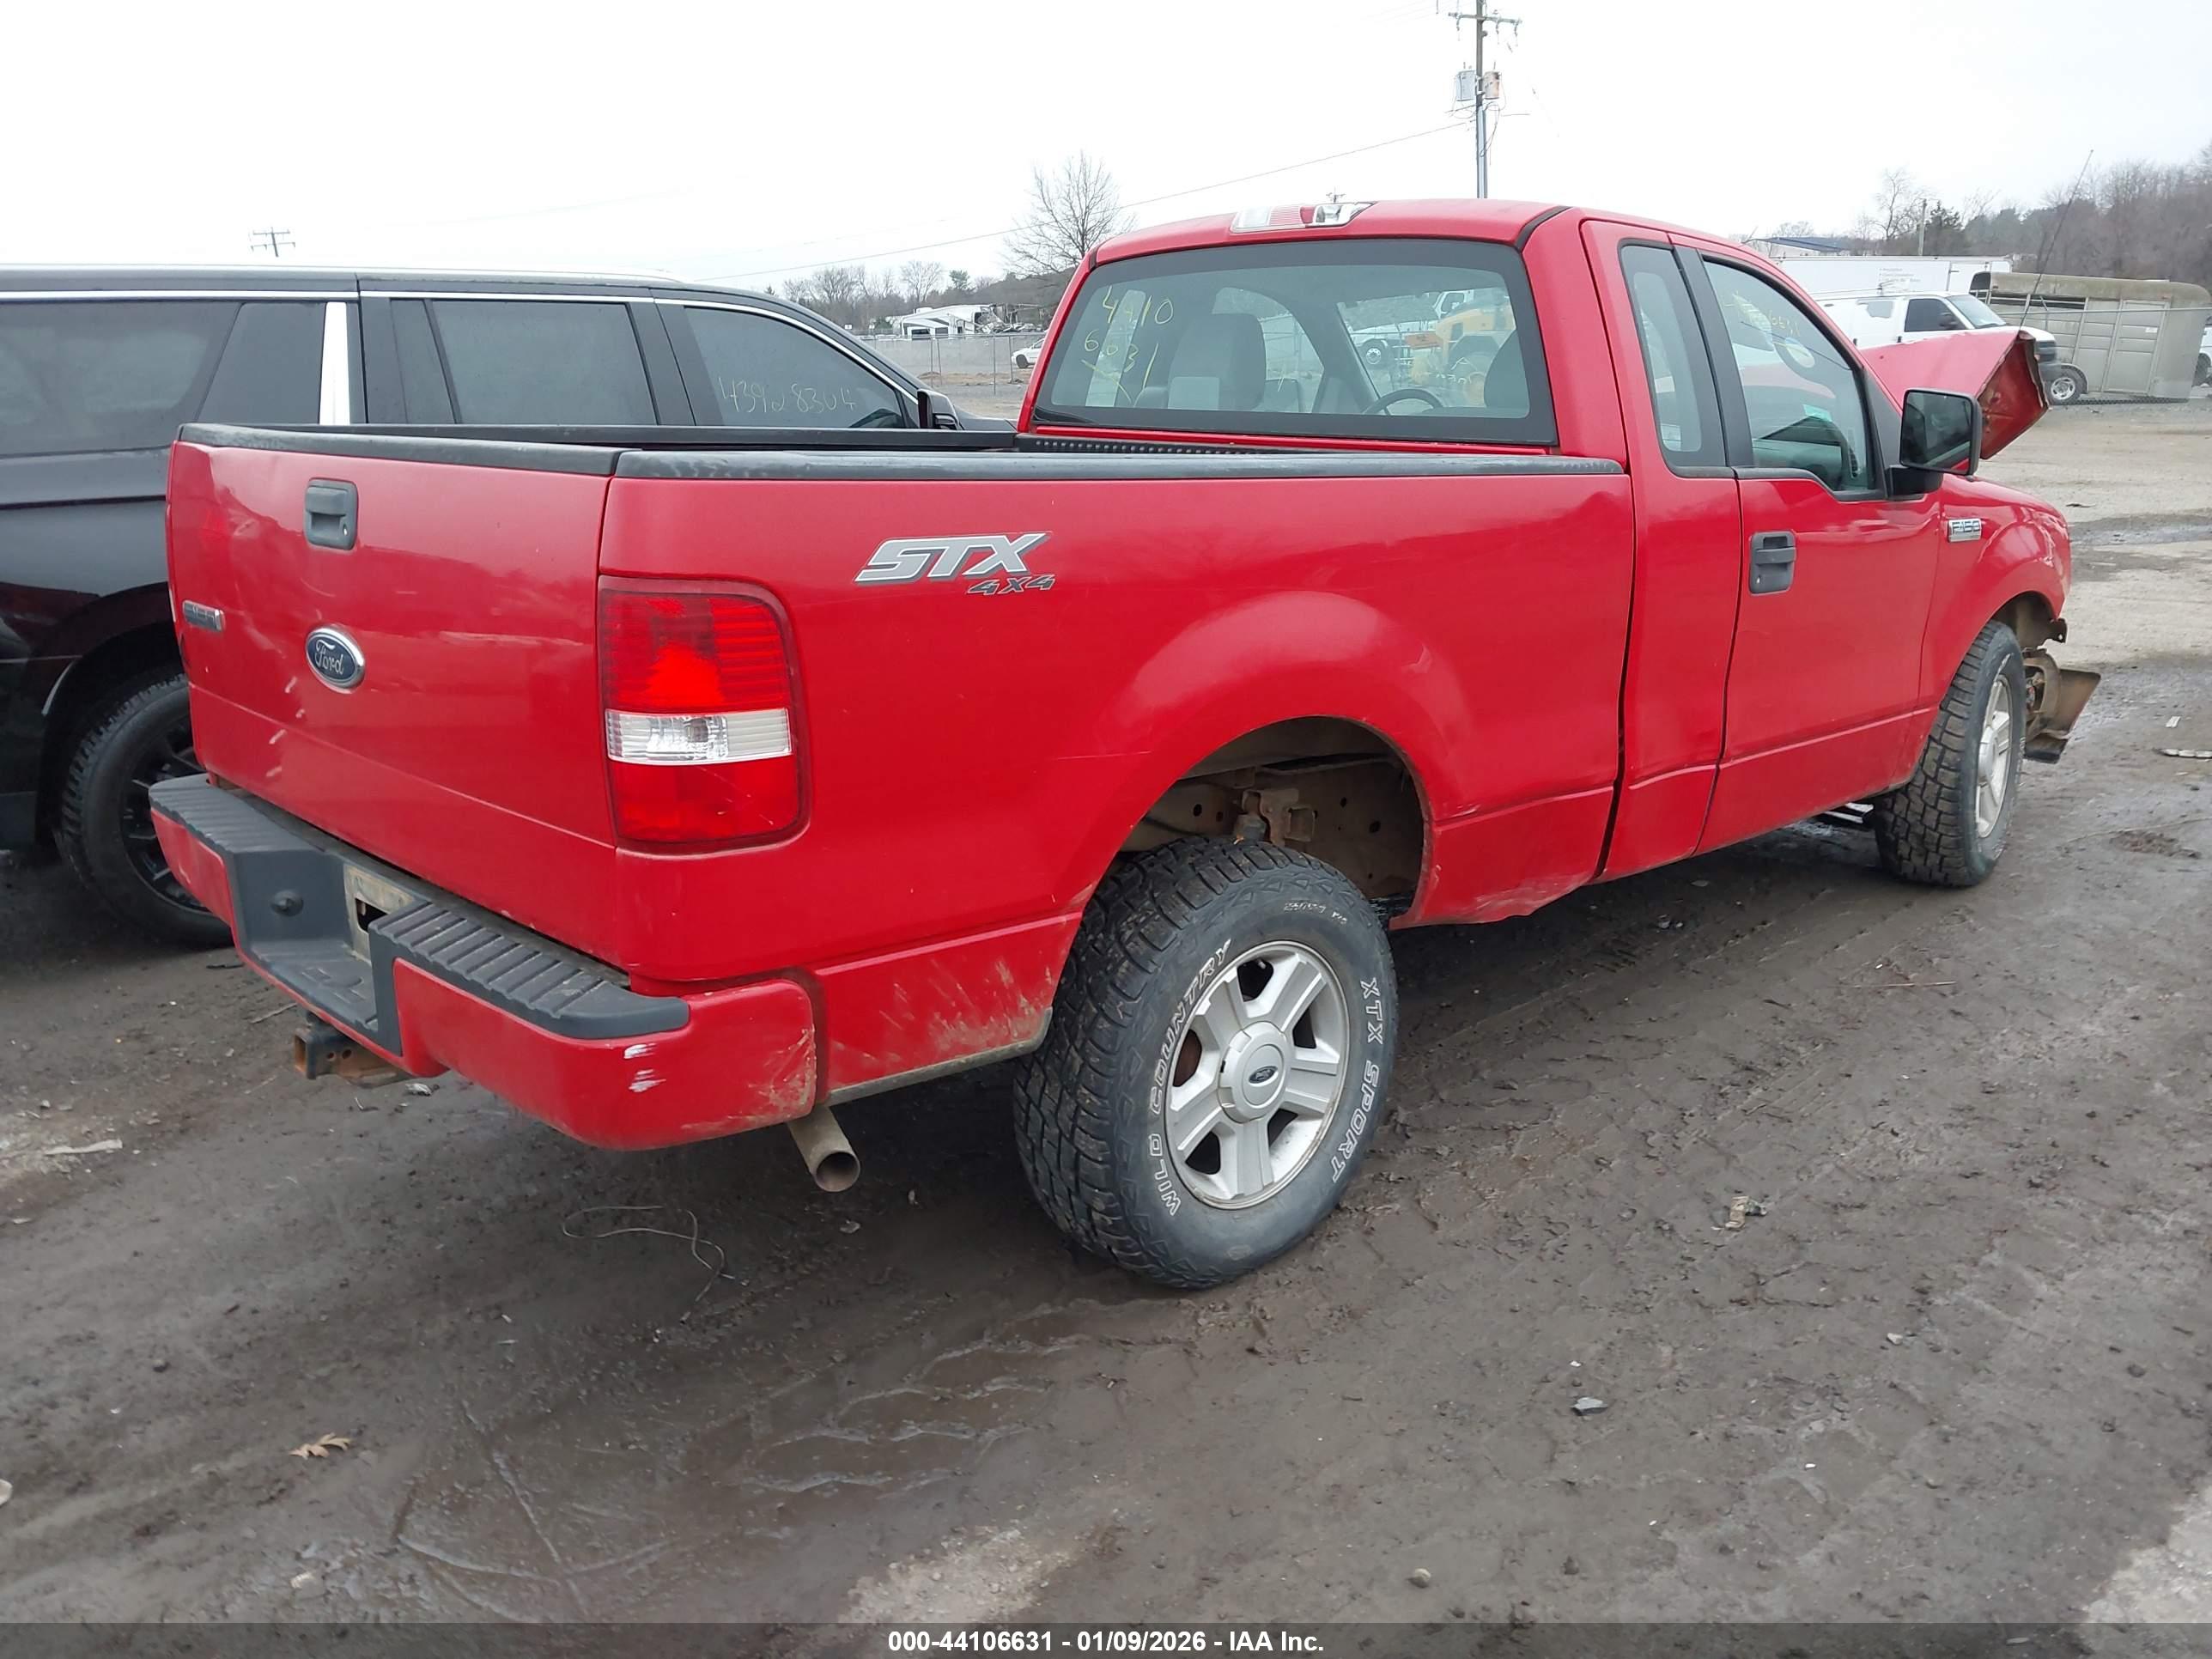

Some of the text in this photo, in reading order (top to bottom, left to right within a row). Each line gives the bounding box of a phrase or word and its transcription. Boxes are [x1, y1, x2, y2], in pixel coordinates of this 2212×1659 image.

[855, 532, 1047, 581] STX
[315, 640, 343, 674] Ford
[1148, 939, 1231, 1215] WILD COUNTRY
[1333, 977, 1383, 1182] XTX SPORT
